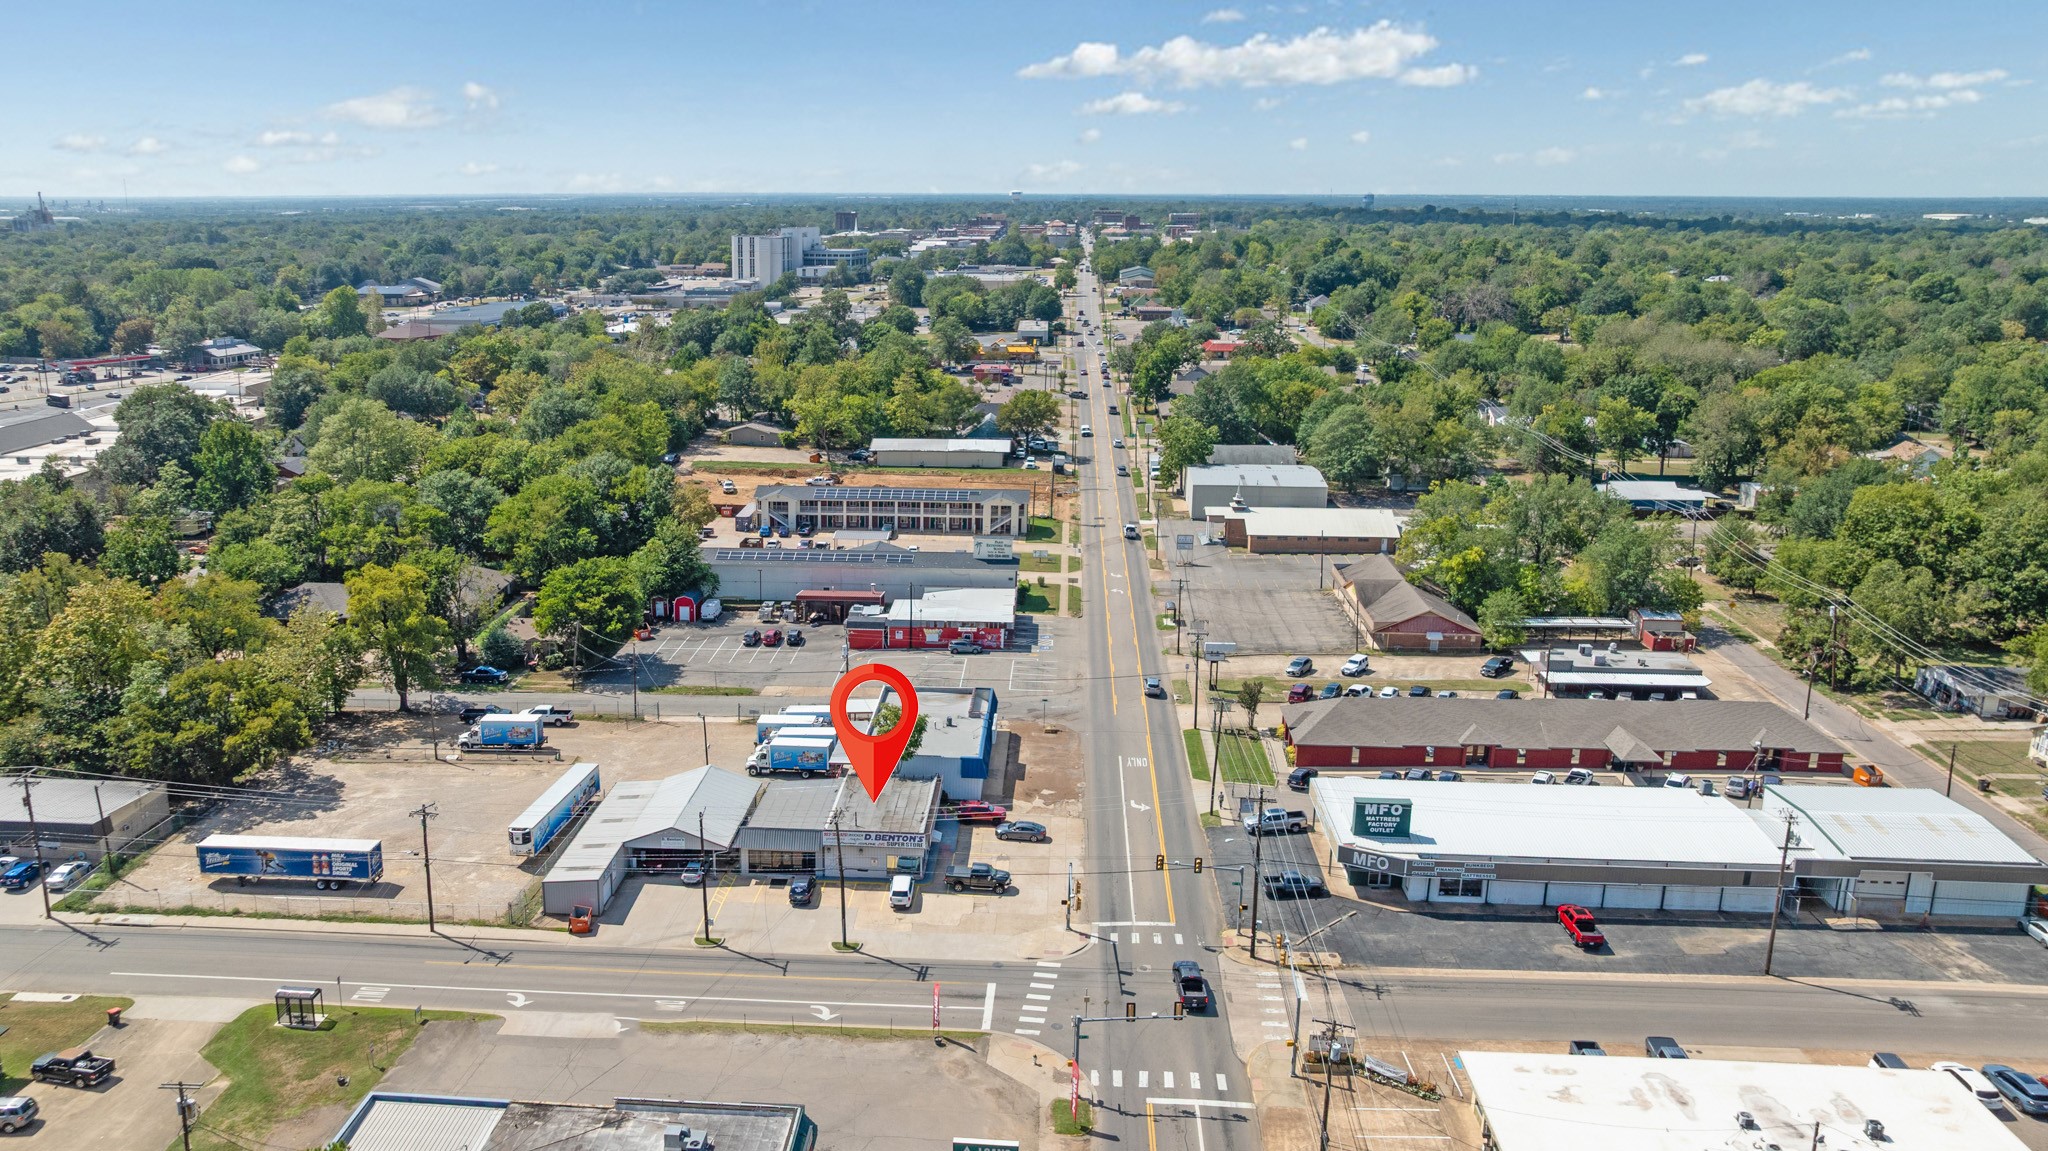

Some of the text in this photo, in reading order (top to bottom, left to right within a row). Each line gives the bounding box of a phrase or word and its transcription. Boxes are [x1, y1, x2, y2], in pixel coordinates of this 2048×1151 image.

[1127, 757, 1148, 767] ONLY
[1364, 804, 1403, 816] MFO
[1352, 851, 1389, 870] MFO
